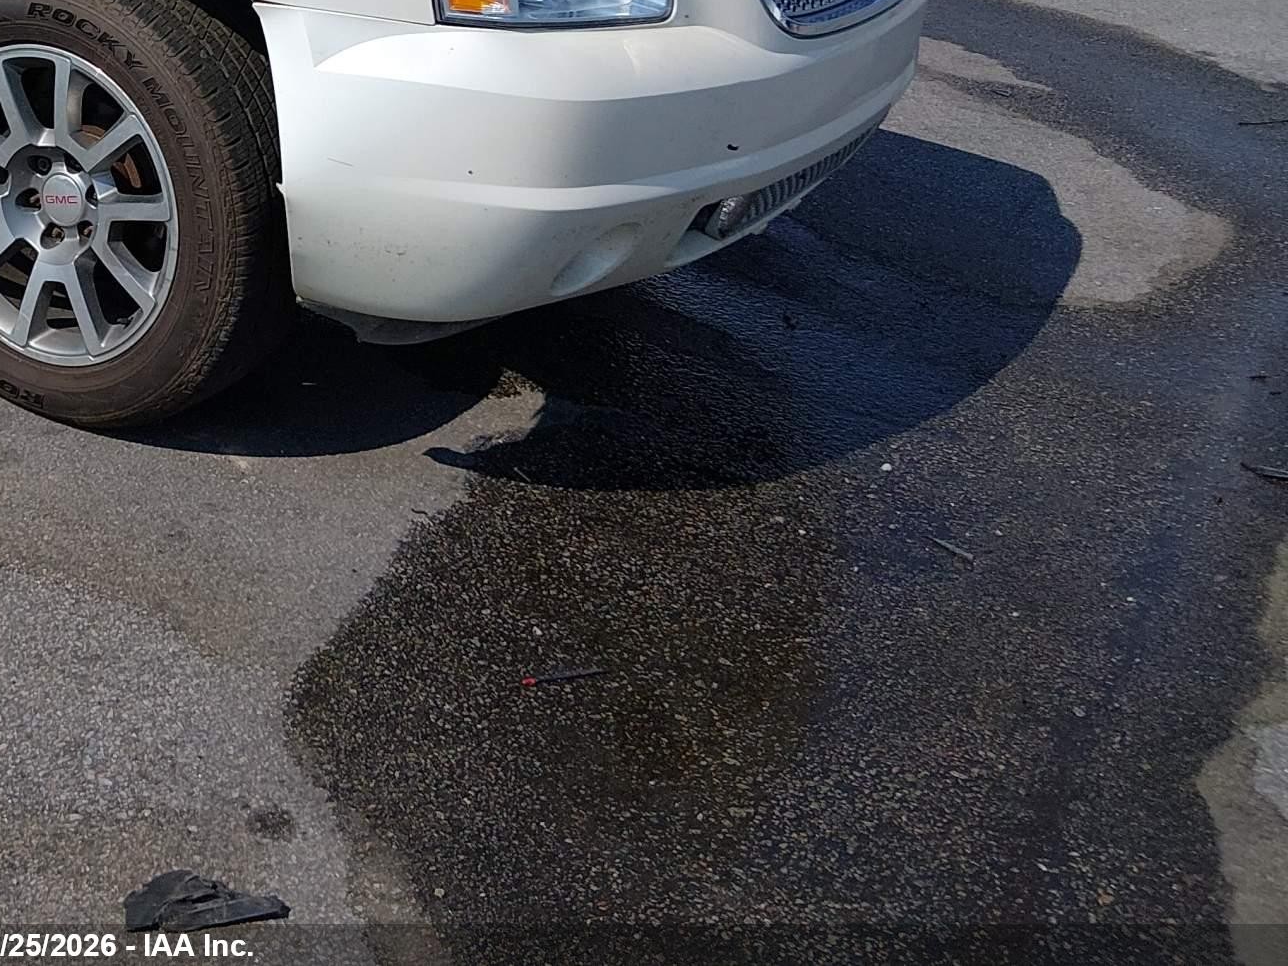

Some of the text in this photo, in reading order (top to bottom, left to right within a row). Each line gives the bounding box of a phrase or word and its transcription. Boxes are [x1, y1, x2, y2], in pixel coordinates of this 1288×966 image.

[27, 2, 216, 292] ROCKY MOUNTAIN
[45, 195, 79, 204] GMC
